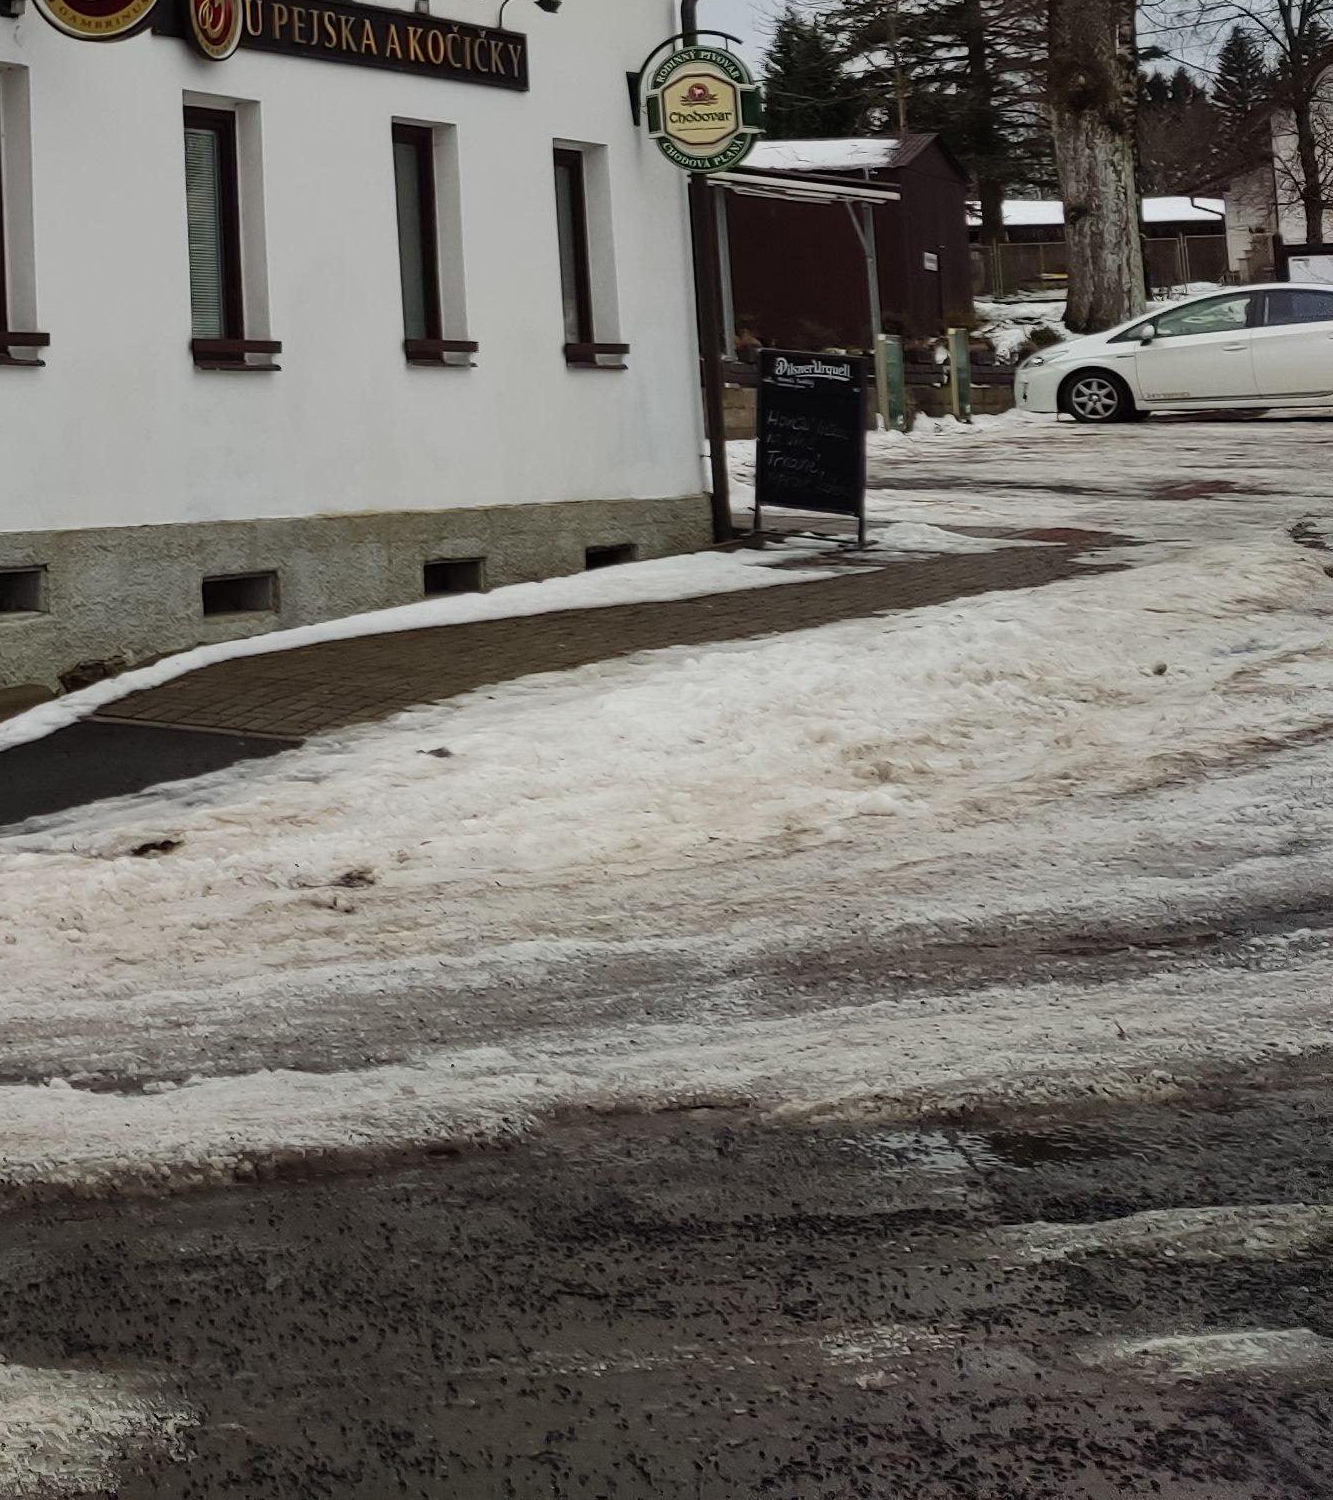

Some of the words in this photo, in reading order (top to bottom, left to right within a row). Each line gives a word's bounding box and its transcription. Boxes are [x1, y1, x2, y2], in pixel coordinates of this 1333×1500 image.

[272, 3, 378, 56] PEJSKA
[386, 23, 403, 60] A
[408, 25, 522, 78] KOČIČKY
[700, 51, 740, 79] PIVOVAR
[669, 110, 732, 124] Chodovar
[662, 141, 711, 168] CHODOVÁ
[775, 357, 813, 377] Pilsner
[812, 359, 851, 379] Urquell
